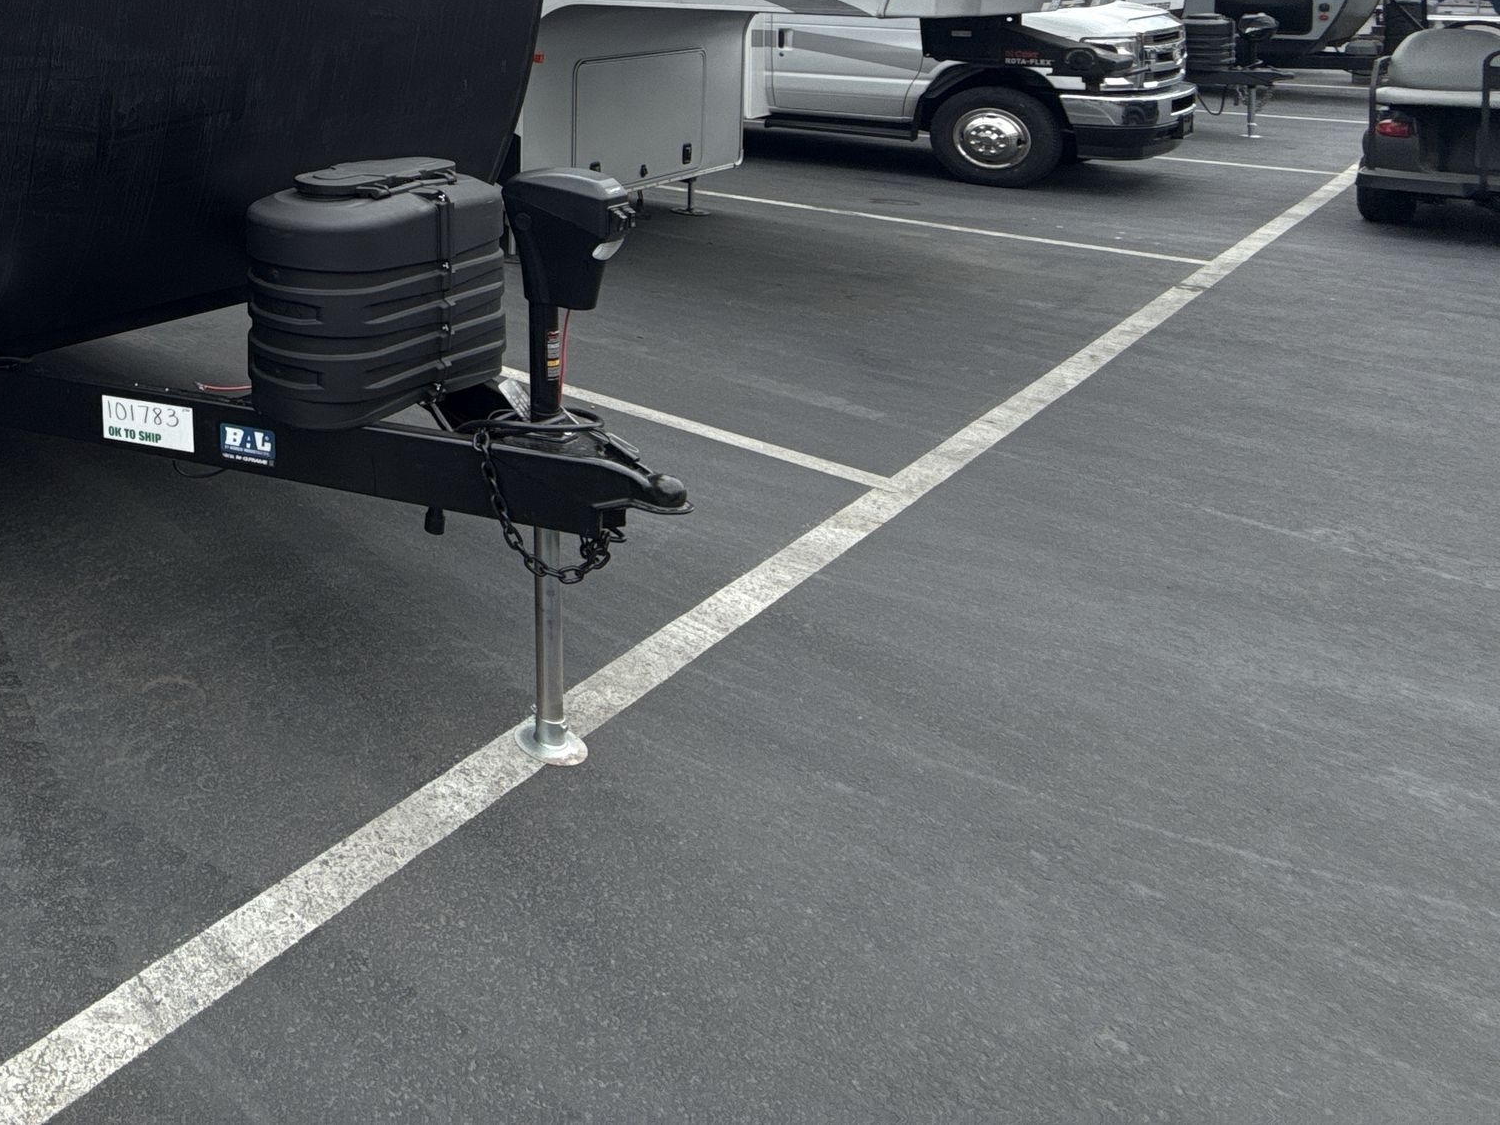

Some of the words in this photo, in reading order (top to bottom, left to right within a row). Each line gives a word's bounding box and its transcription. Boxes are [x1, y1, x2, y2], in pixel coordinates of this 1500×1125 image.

[107, 400, 180, 428] 101783
[108, 425, 122, 438] OK
[124, 428, 136, 440] TO
[138, 430, 162, 443] SHIP
